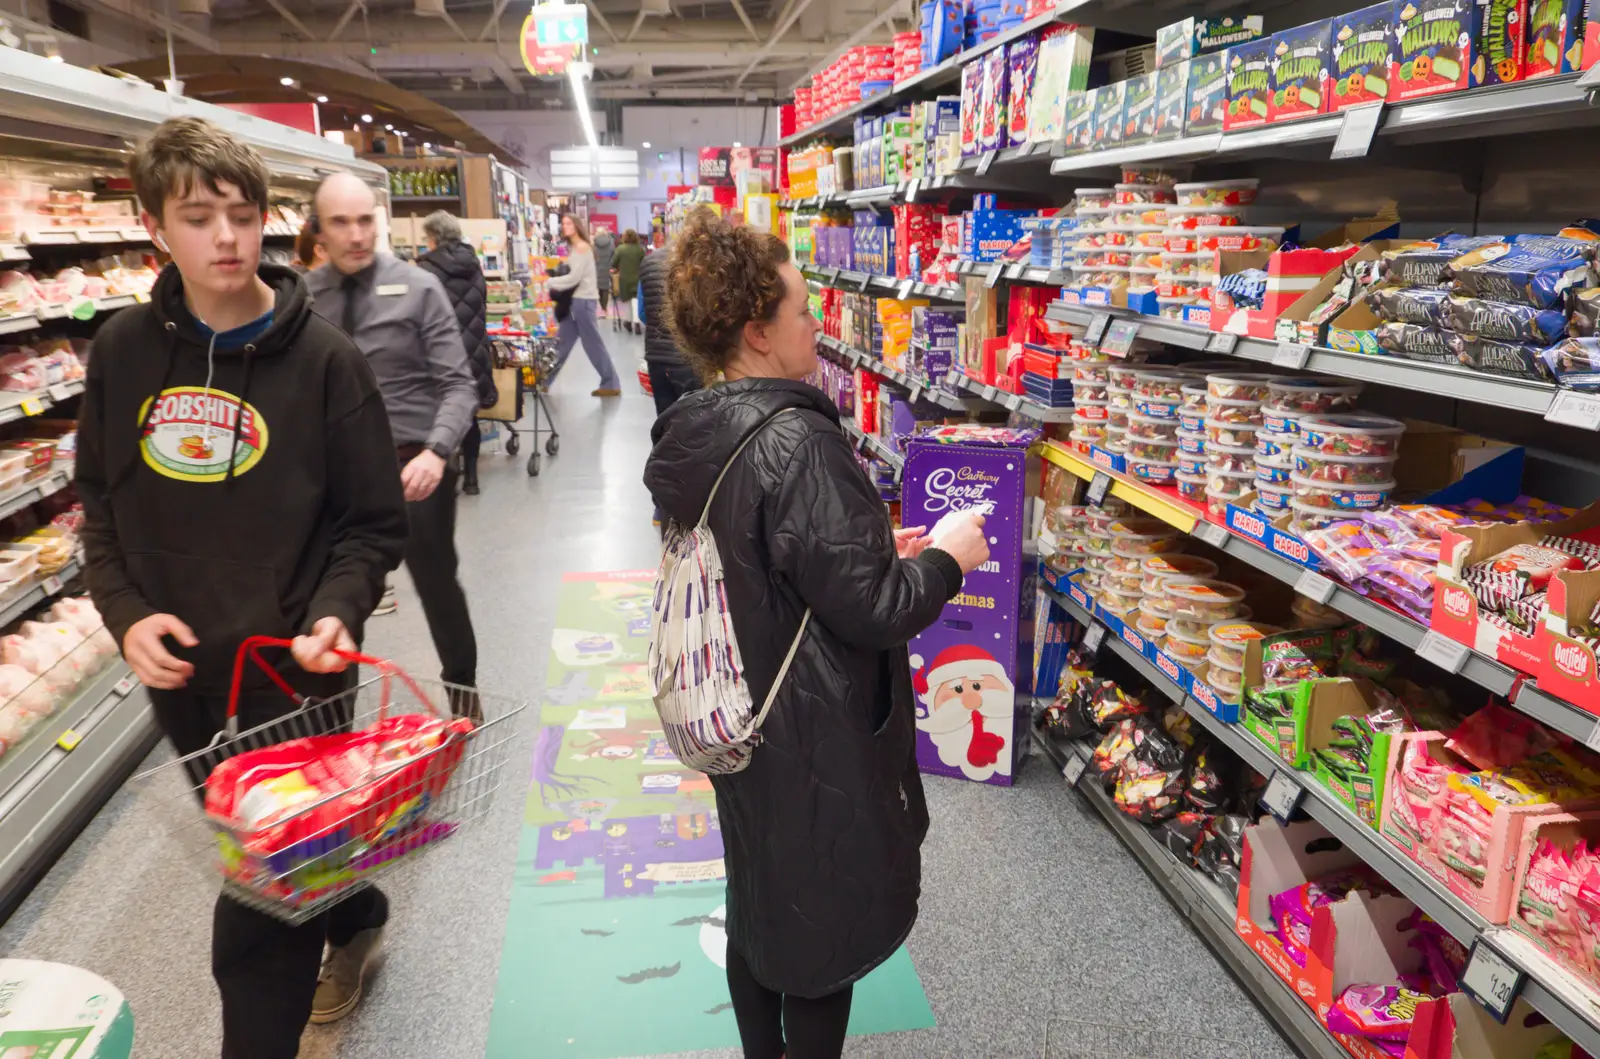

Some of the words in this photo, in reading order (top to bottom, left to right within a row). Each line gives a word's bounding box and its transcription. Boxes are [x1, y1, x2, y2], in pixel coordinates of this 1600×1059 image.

[1401, 20, 1461, 58] MALLOWS
[1338, 42, 1389, 75] MALLOWS
[979, 240, 1013, 250] HARIBO
[981, 250, 1001, 258] Star
[1402, 262, 1443, 281] ADDAM
[1189, 307, 1210, 321] HARIB
[1404, 331, 1445, 351] ADDAM
[148, 394, 251, 433] GOBSHITE
[923, 467, 993, 512] Secret
[957, 466, 1000, 485] Cadbury
[1233, 510, 1266, 538] HARIBO
[1273, 532, 1309, 563] HARIBO
[947, 592, 996, 610] stmas
[1554, 642, 1588, 674] Oatfield
[1490, 973, 1511, 1003] £1.20
